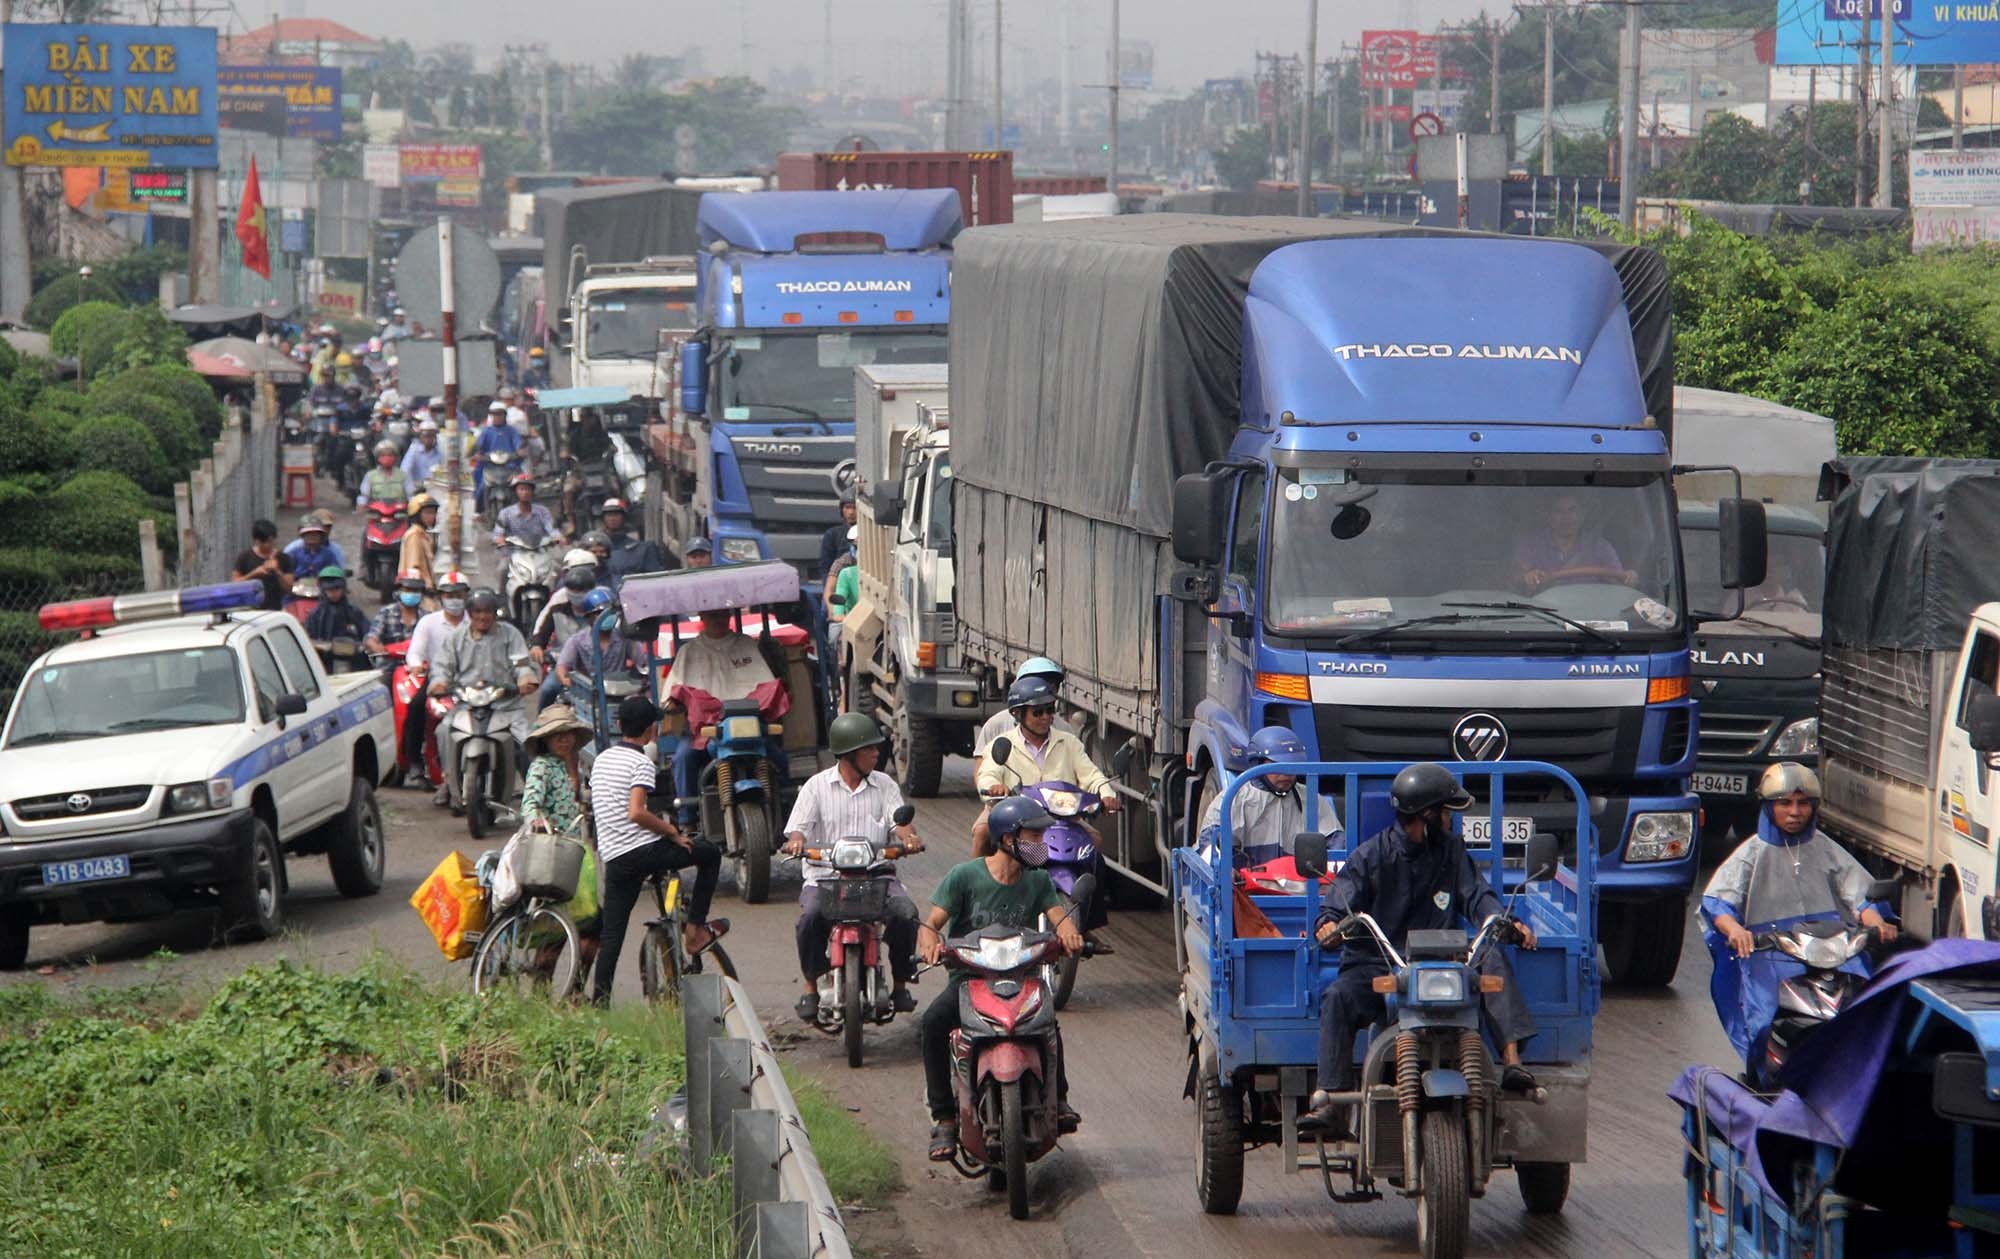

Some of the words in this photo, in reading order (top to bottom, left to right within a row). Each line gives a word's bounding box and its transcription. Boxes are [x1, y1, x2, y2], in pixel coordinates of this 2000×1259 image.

[47, 36, 110, 73] BÃI
[127, 44, 177, 73] XE
[24, 73, 112, 114] MIỀN
[123, 86, 200, 115] NAM
[1932, 168, 1964, 176] MINH
[776, 281, 841, 294] THACO
[843, 280, 912, 293] AUMAN
[1334, 343, 1453, 361] THACO
[1457, 344, 1582, 366] AUMAN
[743, 443, 802, 455] THACO
[1317, 661, 1388, 674] THACO
[1567, 662, 1641, 676] AUMAN
[47, 857, 125, 882] 51B-0483
